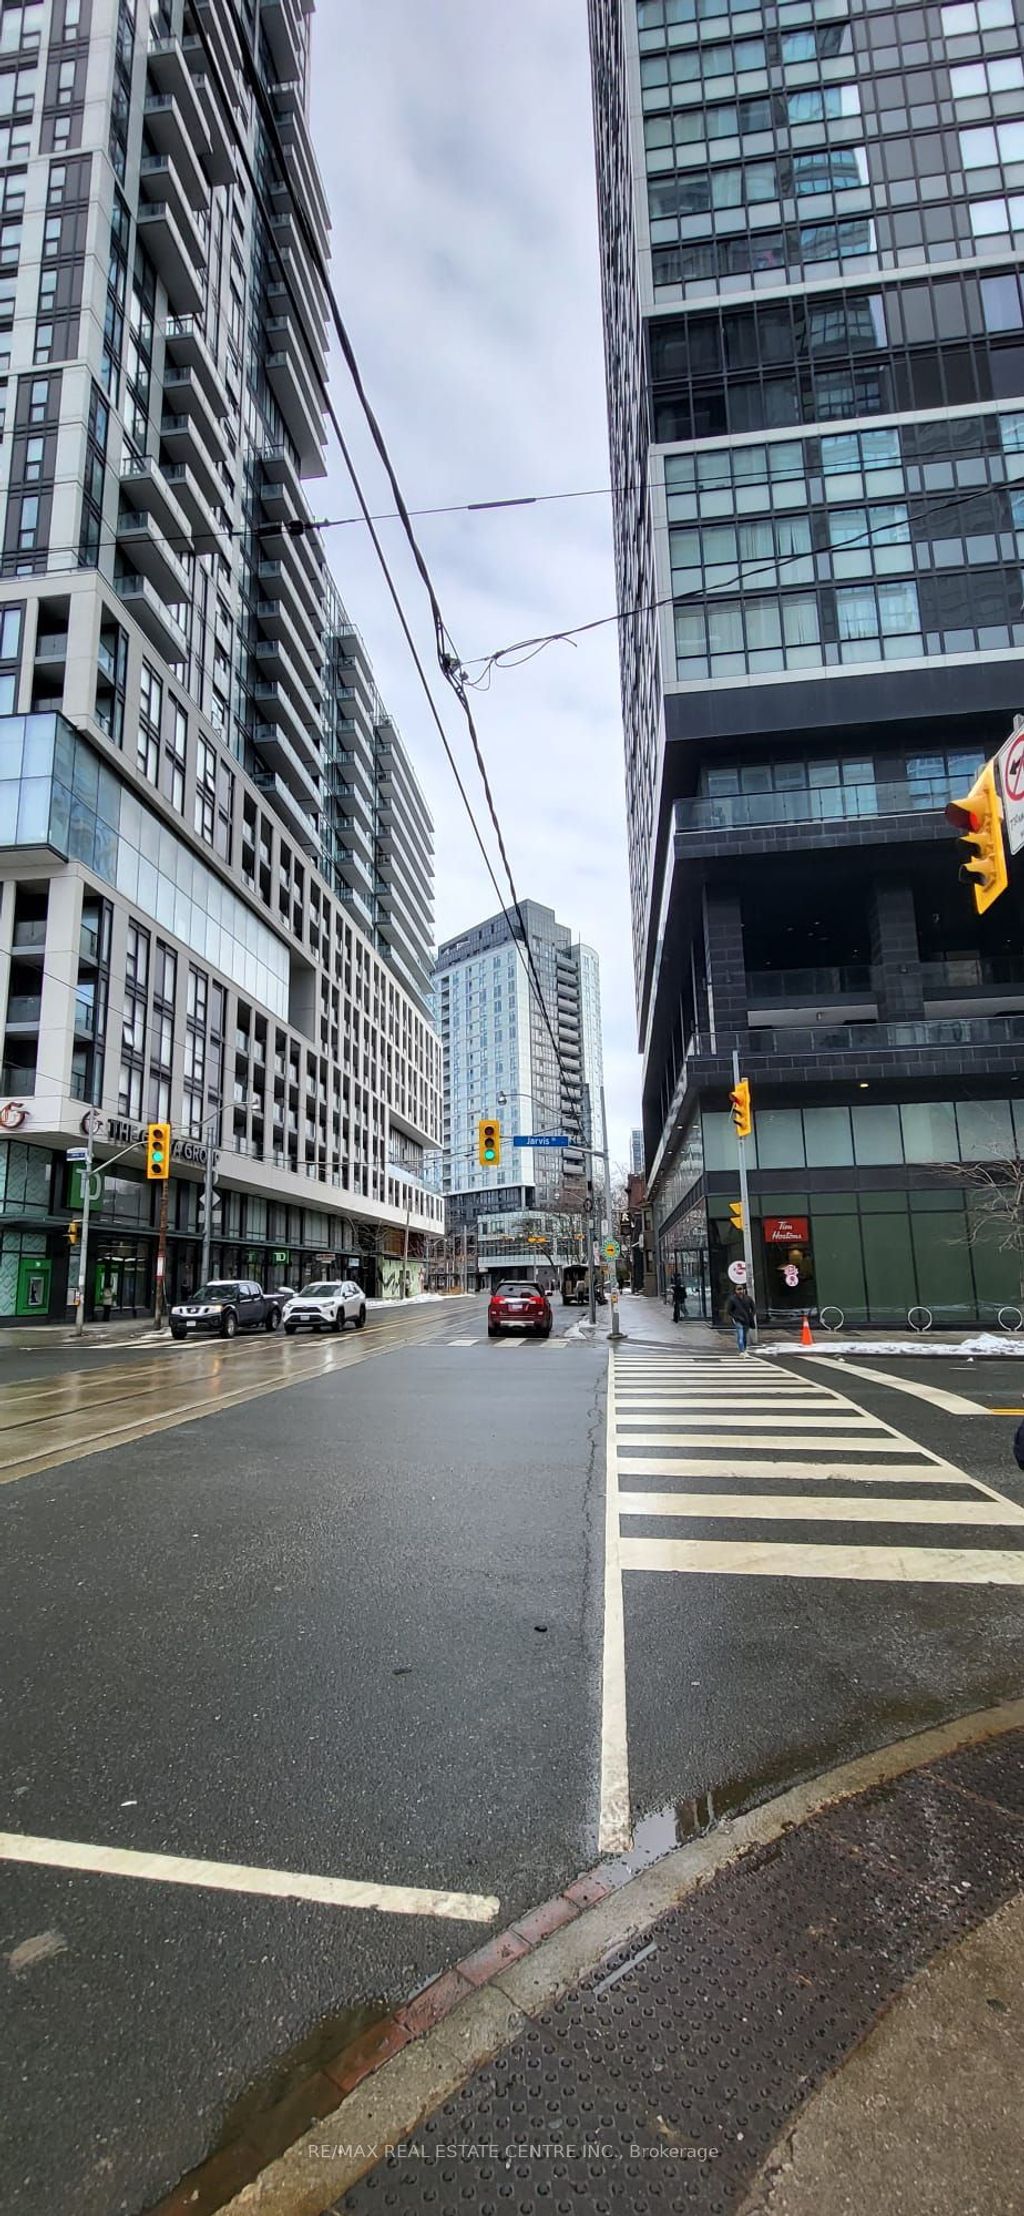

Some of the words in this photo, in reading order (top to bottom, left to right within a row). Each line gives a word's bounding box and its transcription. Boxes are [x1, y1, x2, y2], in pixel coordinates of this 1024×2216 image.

[107, 1119, 139, 1143] THE
[526, 1136, 550, 1145] Jarvis
[777, 1221, 793, 1230] Tim
[272, 1252, 286, 1262] TD
